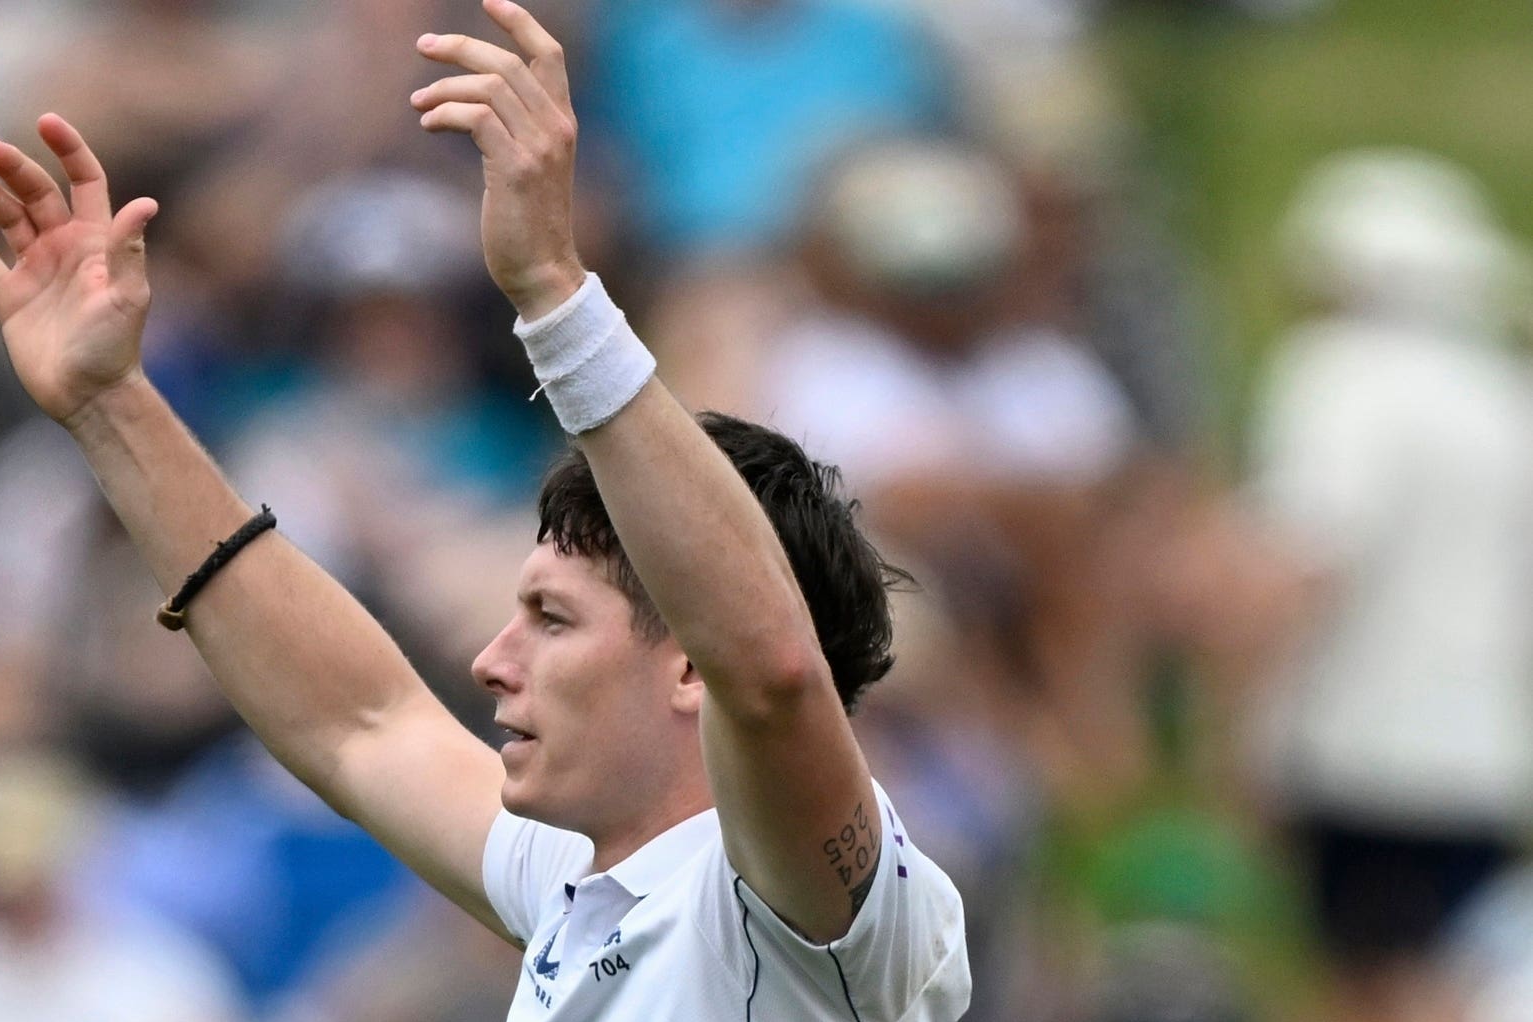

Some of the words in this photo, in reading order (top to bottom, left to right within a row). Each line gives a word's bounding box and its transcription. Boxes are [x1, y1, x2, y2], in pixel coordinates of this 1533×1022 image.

[823, 801, 868, 865] 265
[837, 826, 878, 886] 704
[589, 953, 630, 982] 704
